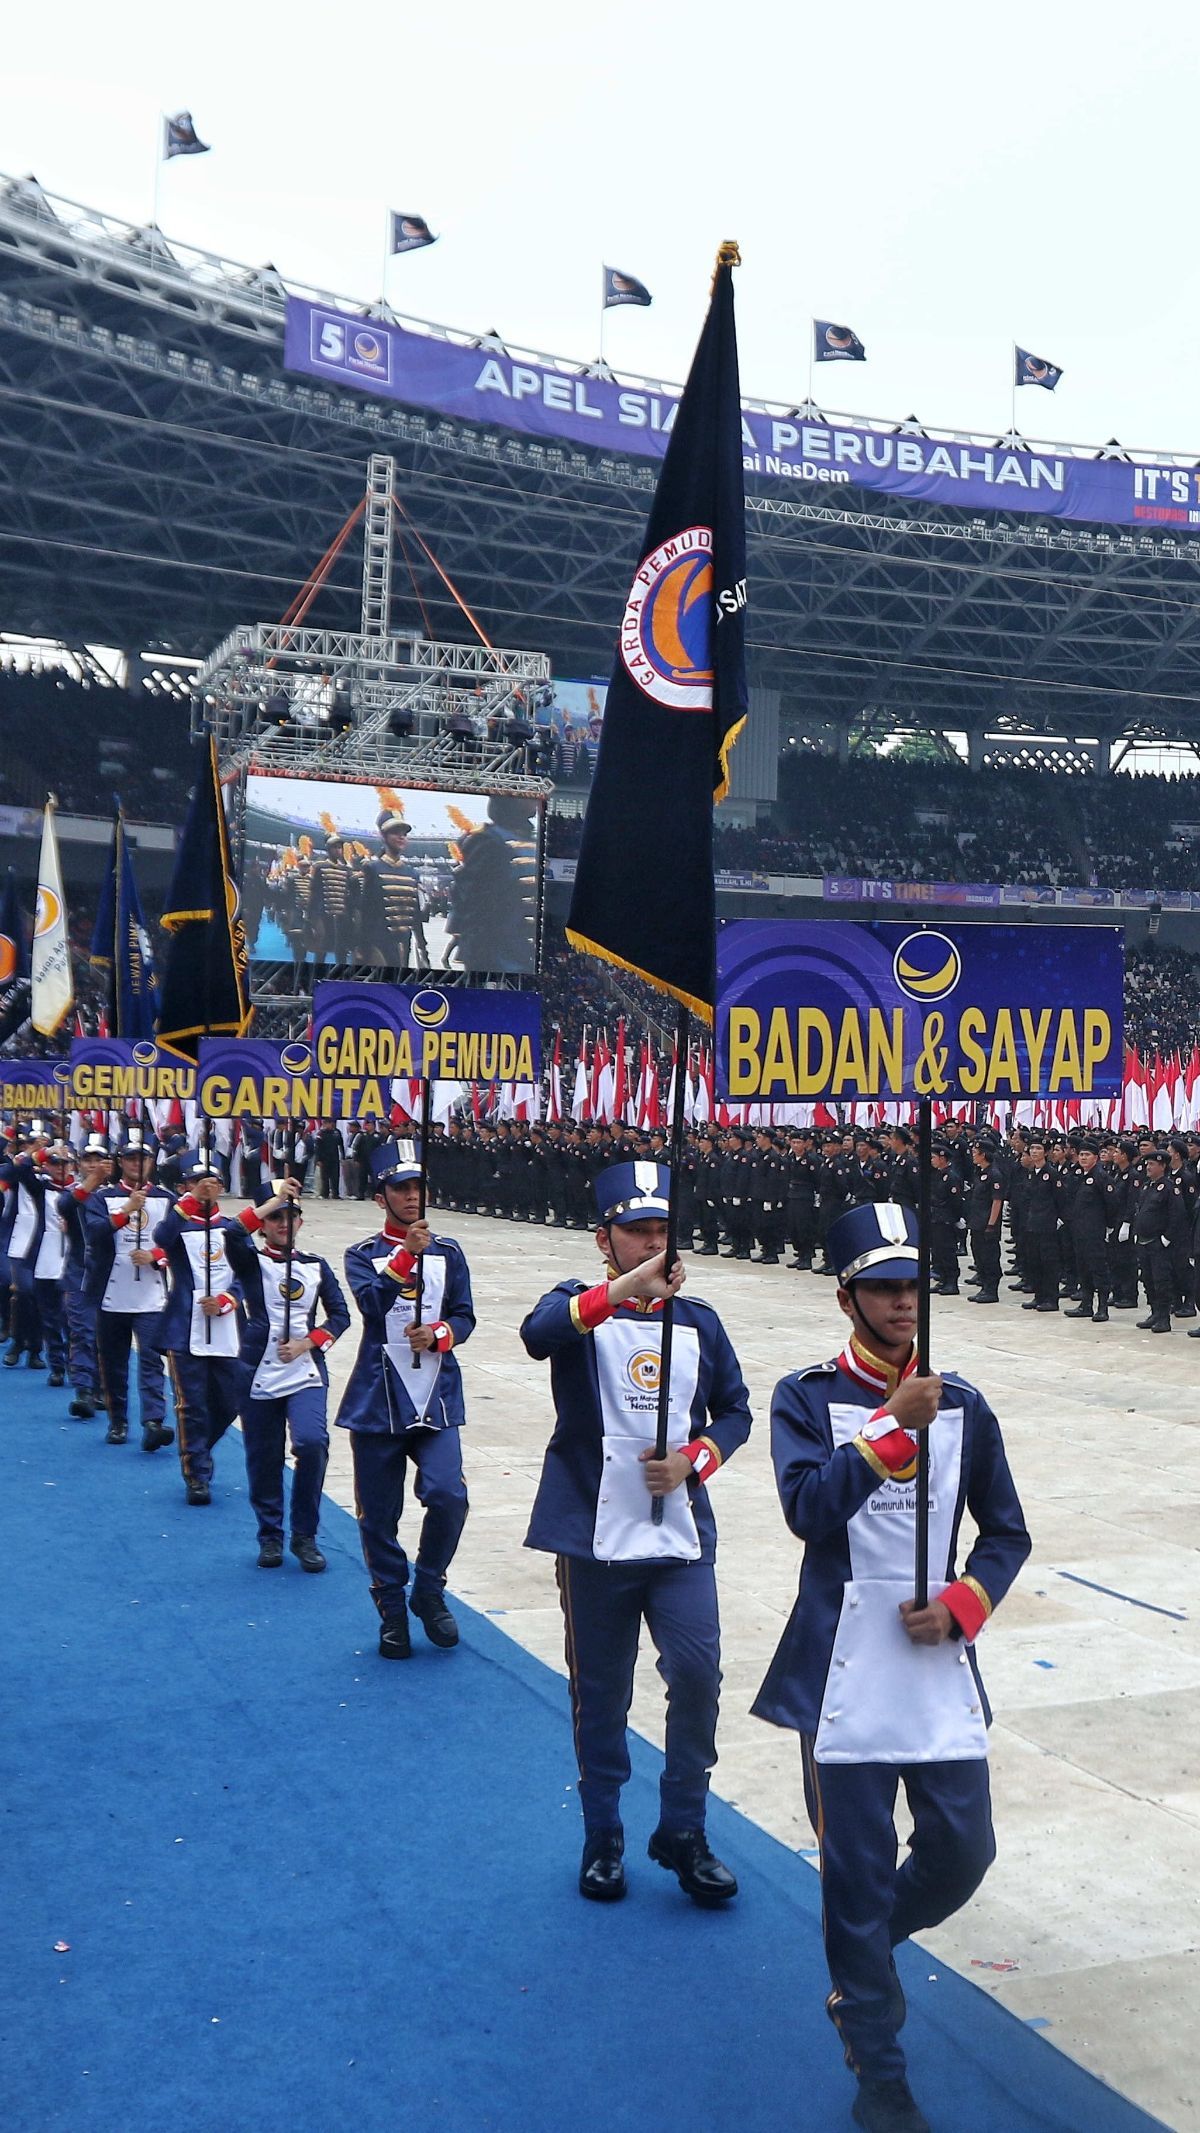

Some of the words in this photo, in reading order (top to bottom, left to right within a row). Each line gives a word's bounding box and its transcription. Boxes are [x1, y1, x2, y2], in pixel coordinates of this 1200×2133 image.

[319, 322, 345, 360] 5
[474, 358, 604, 419] APEL
[771, 420, 1065, 492] PERUBAHAN
[765, 454, 850, 482] NasDem
[1134, 468, 1190, 503] IT'S
[637, 531, 711, 587] PEMUD
[623, 598, 656, 687] GARDA
[830, 882, 840, 895] 5
[861, 881, 893, 899] IT'S
[894, 883, 935, 900] TIME!
[127, 952, 141, 995] DEWAN
[317, 1026, 414, 1078] GARDA
[422, 1030, 534, 1082] PEMUDA
[727, 1006, 904, 1097] BADAN
[912, 1010, 951, 1096] &
[957, 1006, 1111, 1095] SAYAP
[2, 1083, 59, 1110] BADAN
[73, 1064, 197, 1099] GEMURU
[201, 1075, 385, 1119] GARNITA
[624, 1395, 638, 1403] Liga
[631, 1403, 660, 1411] NasDe
